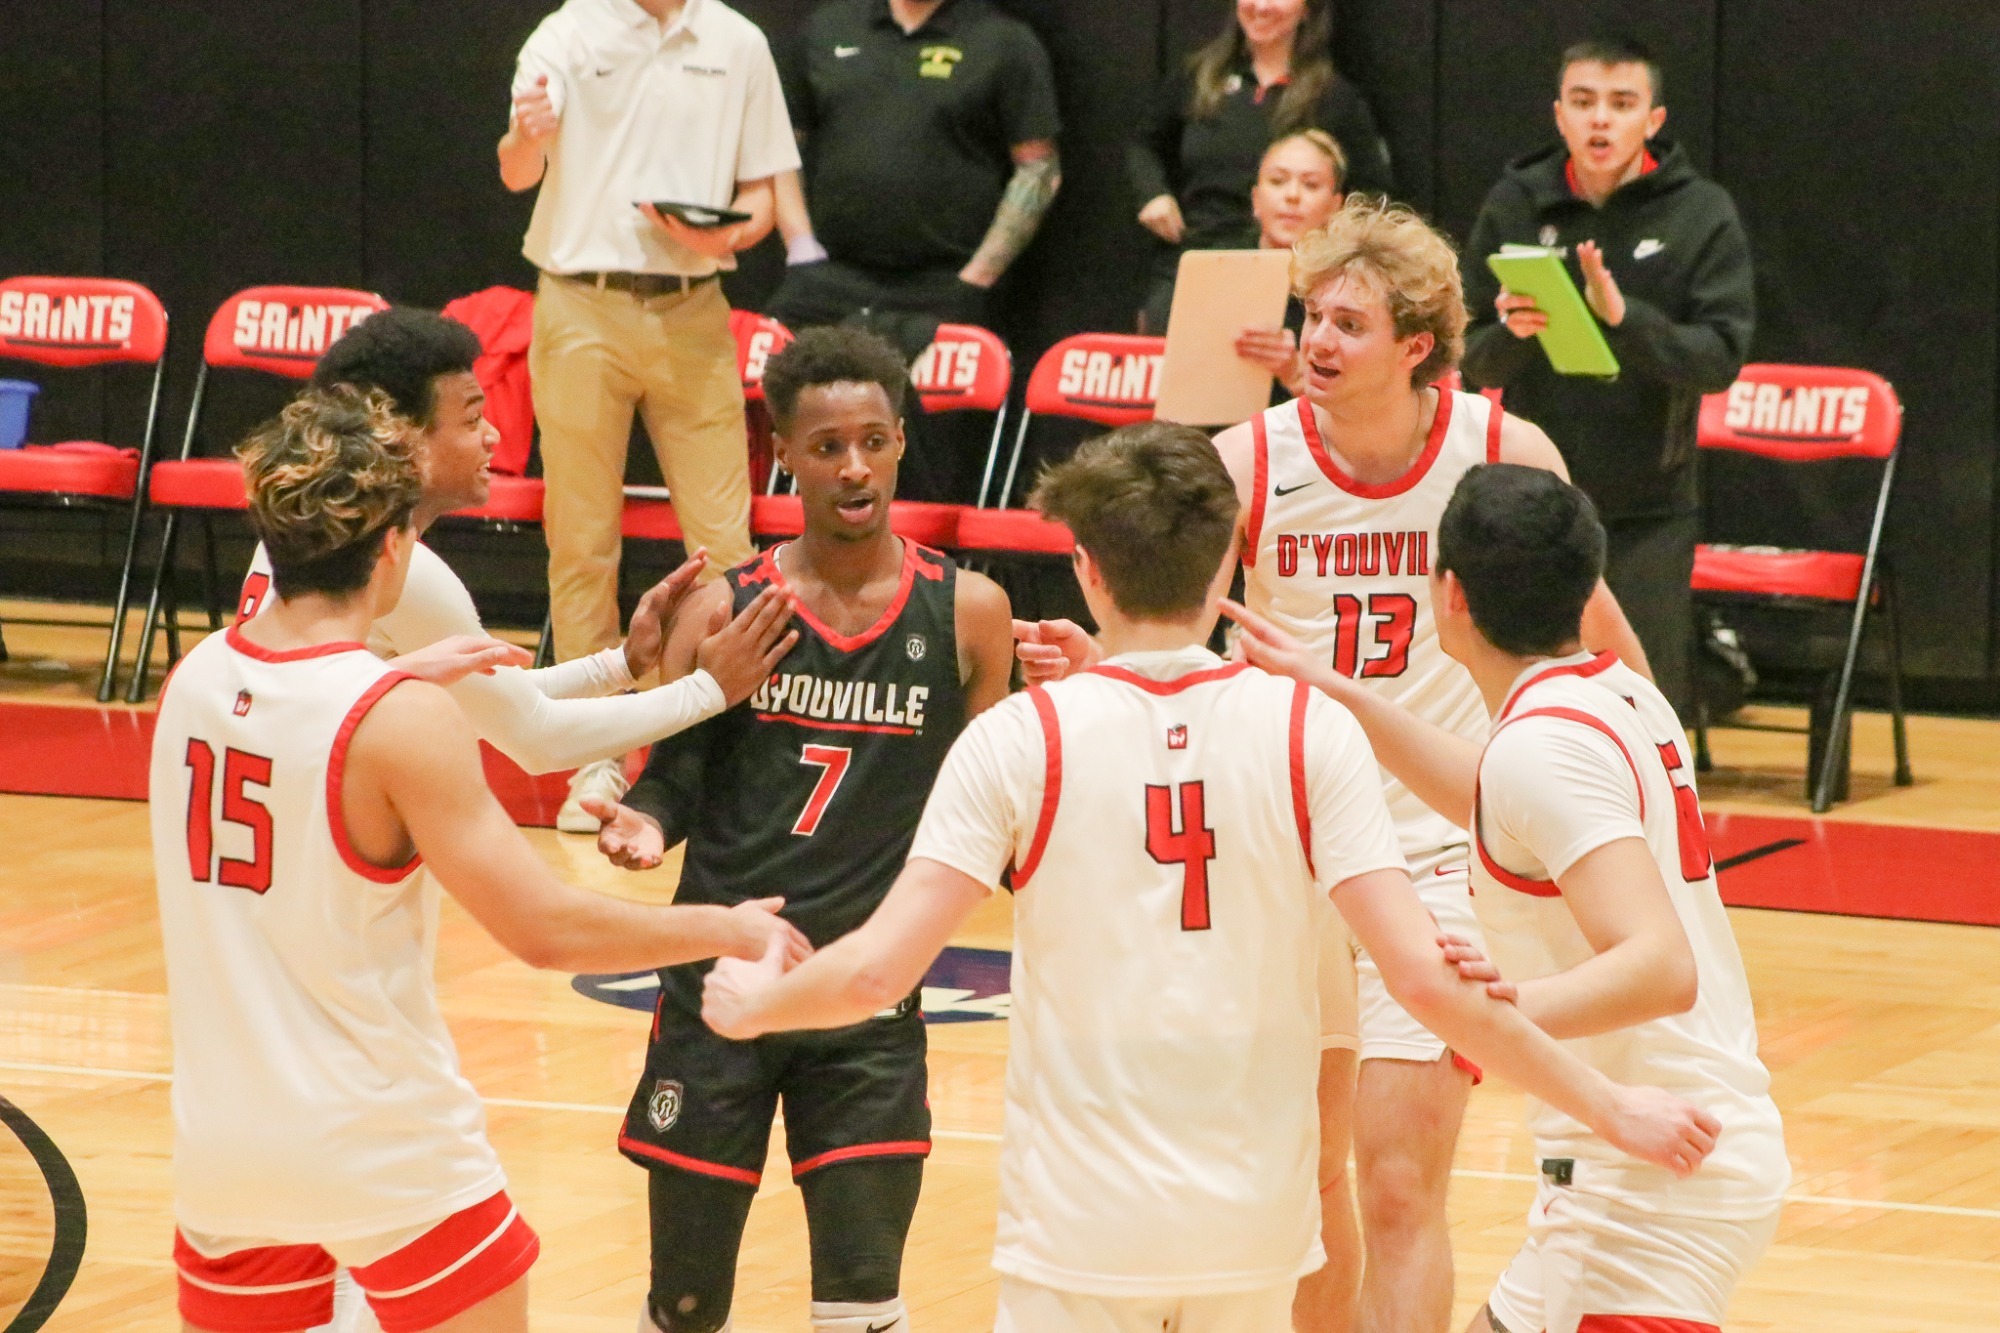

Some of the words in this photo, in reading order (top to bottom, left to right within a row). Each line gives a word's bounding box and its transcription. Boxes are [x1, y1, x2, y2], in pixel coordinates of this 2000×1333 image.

[1057, 349, 1165, 400] SAiNT
[1277, 531, 1429, 578] D'YOUVIL
[1332, 592, 1418, 680] 13
[185, 737, 273, 895] 15
[790, 743, 852, 837] 7
[1145, 779, 1217, 932] 4
